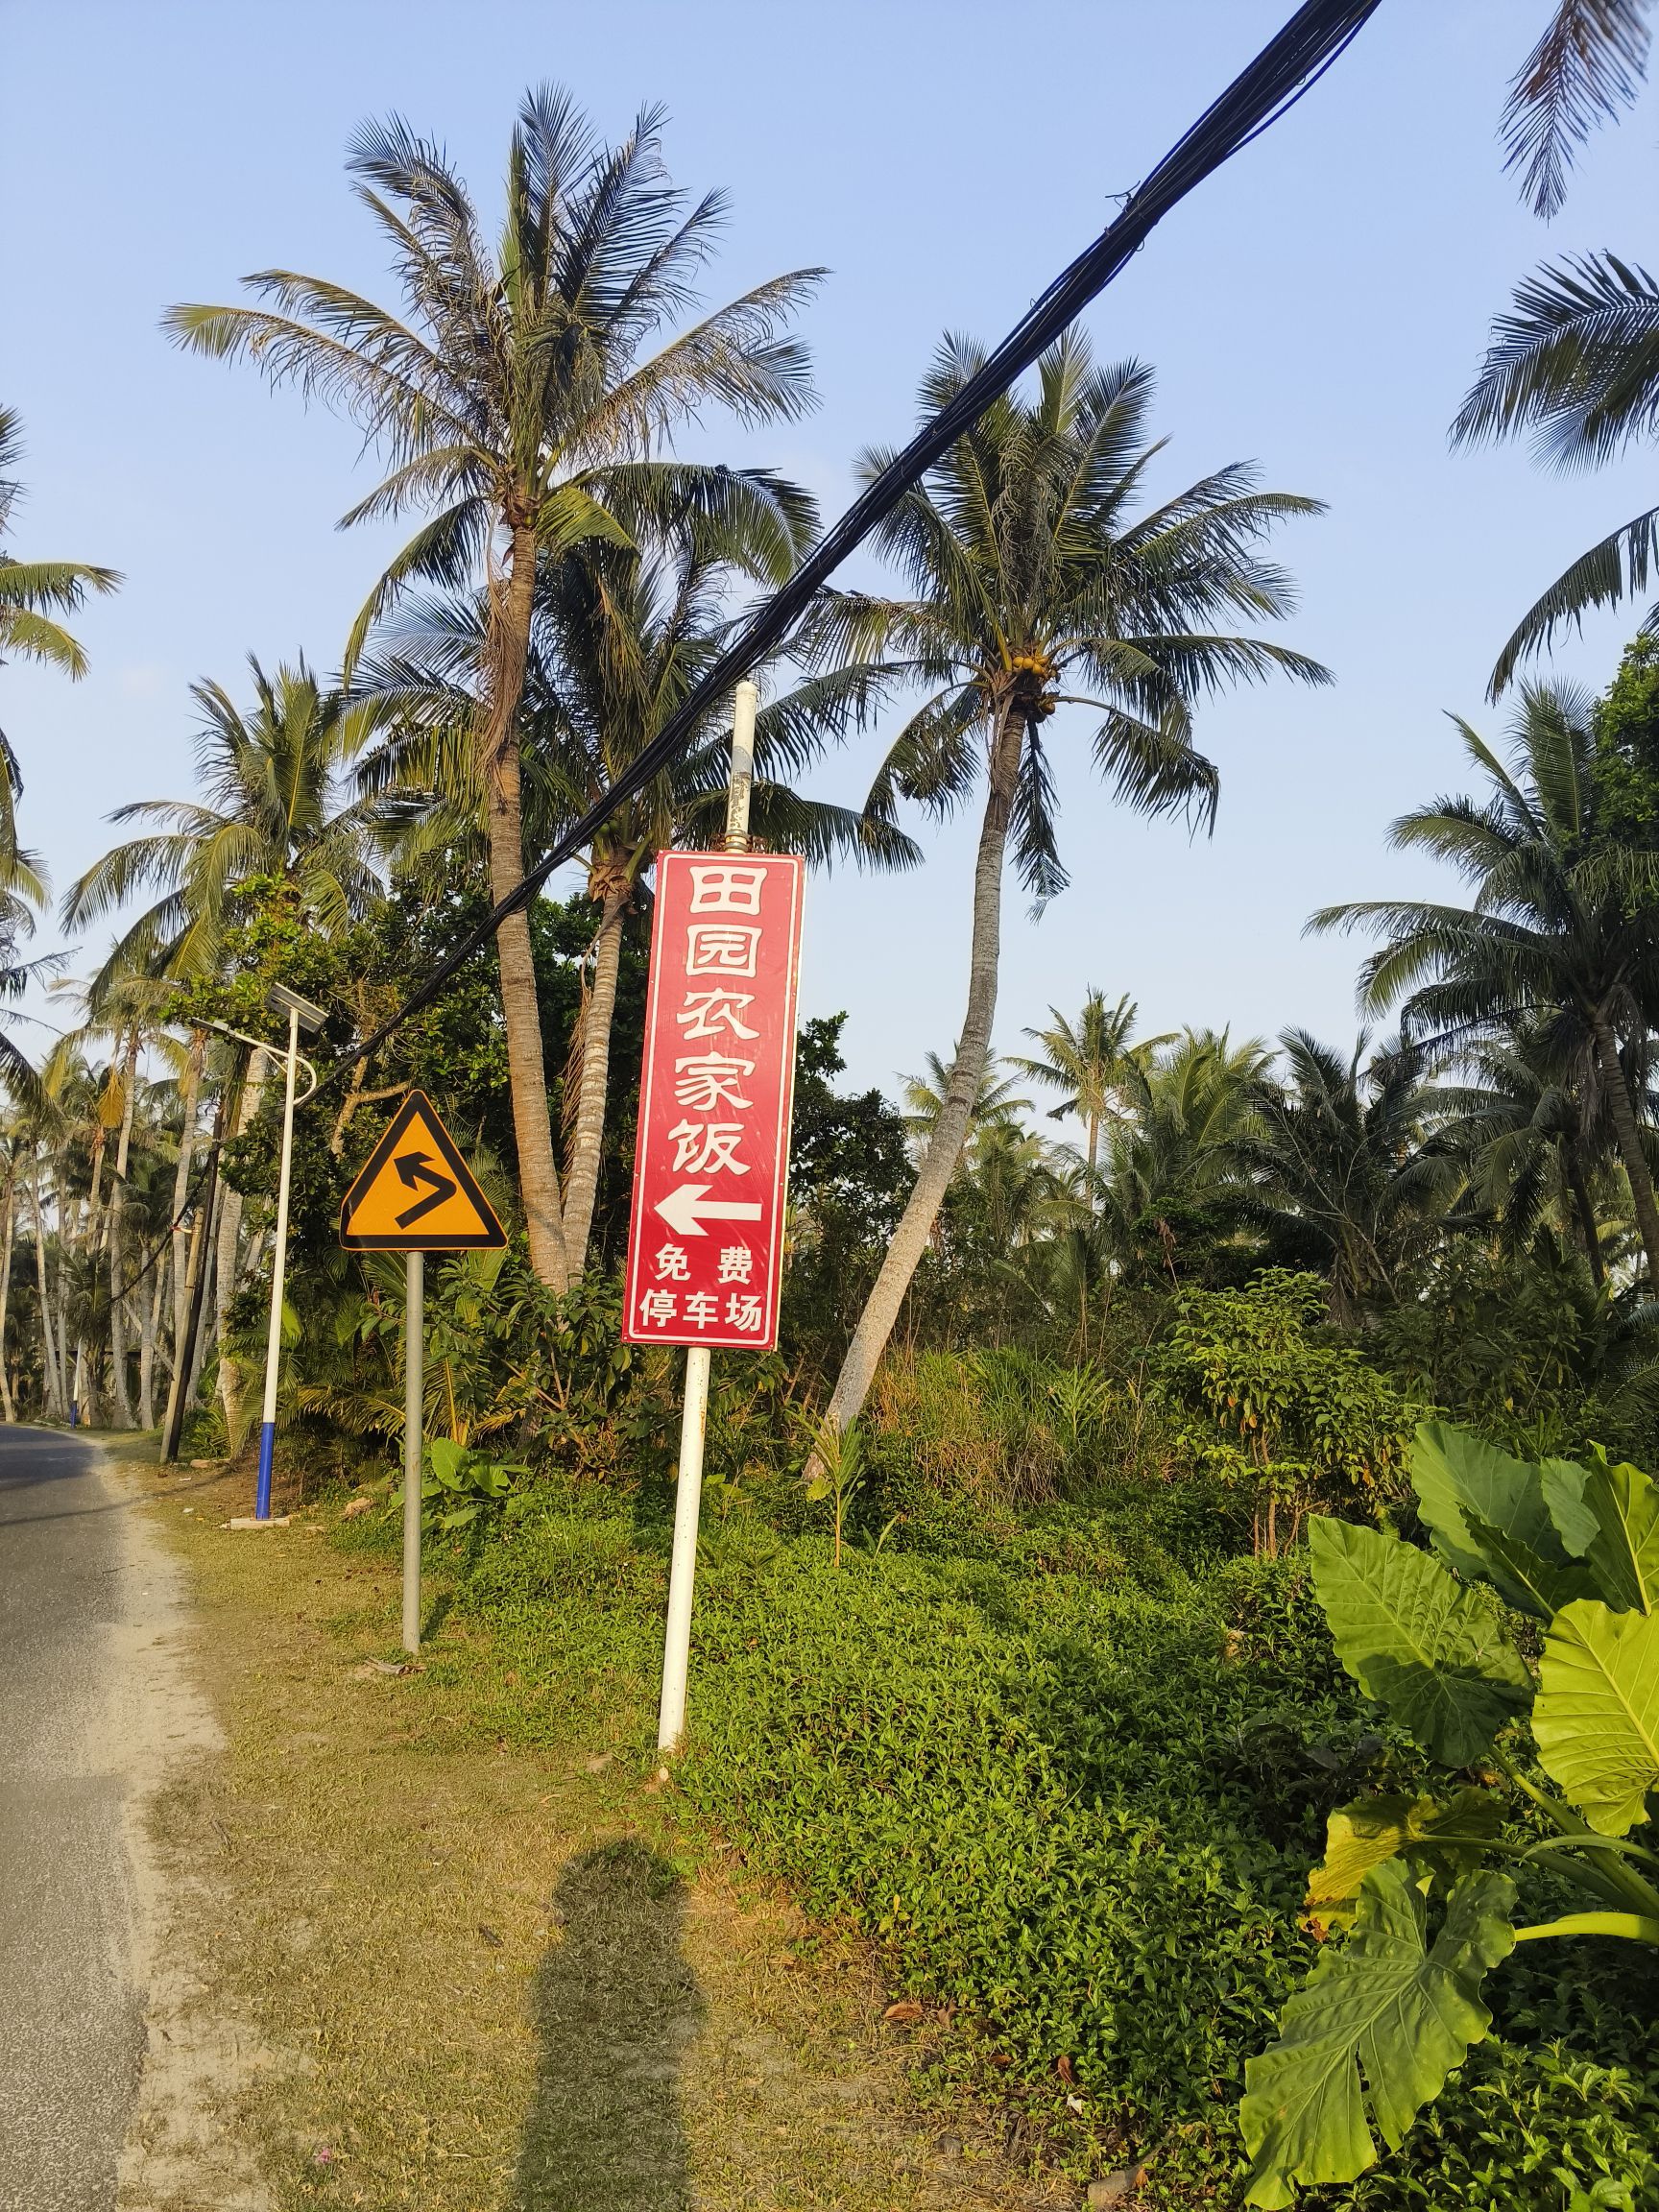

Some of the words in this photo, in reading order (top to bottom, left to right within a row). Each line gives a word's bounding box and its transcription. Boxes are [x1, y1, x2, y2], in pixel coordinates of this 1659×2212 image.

[667, 865, 767, 1176] 田园农家饭
[654, 1242, 754, 1286] 免费
[638, 1287, 763, 1332] 停车场
